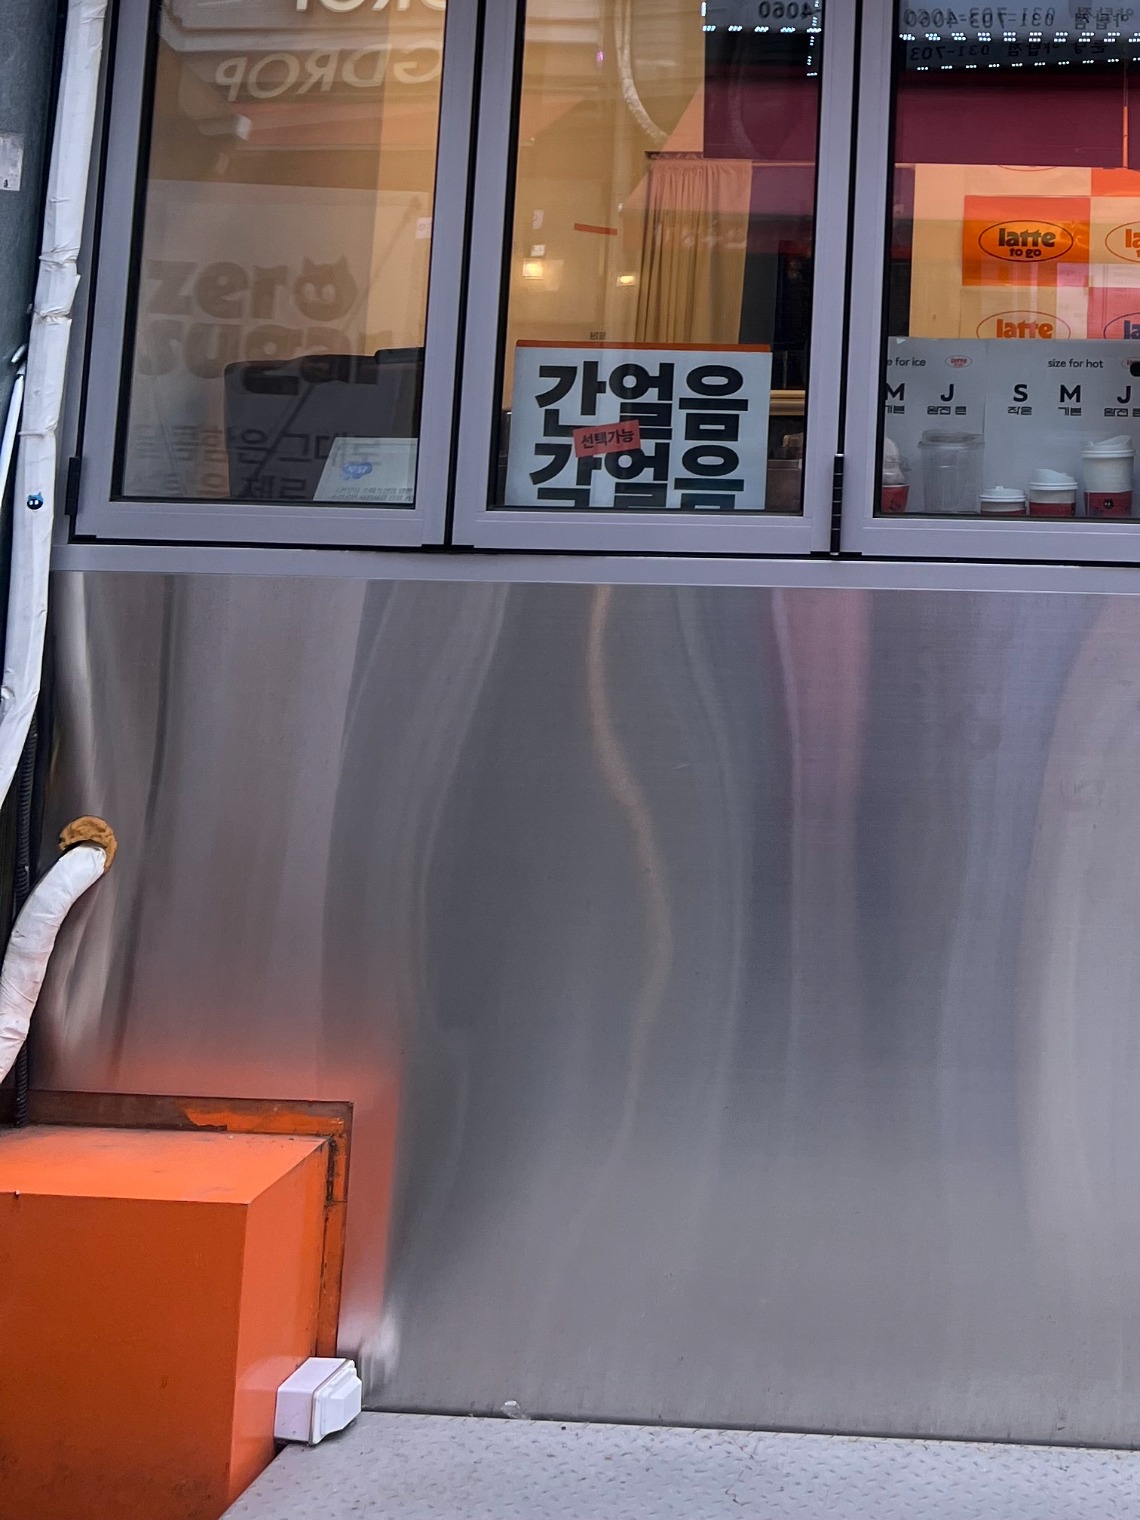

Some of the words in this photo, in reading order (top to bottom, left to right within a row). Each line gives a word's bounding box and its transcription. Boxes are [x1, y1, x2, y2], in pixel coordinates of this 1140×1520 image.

[998, 227, 1056, 248] latte
[1009, 248, 1024, 258] to
[1025, 249, 1042, 259] go
[996, 318, 1054, 339] latte
[895, 357, 911, 367] for
[912, 357, 927, 367] ice
[1047, 358, 1067, 368] size
[1068, 358, 1085, 368] for
[1086, 358, 1104, 369] hot
[940, 383, 955, 402] J
[1013, 384, 1029, 403] S
[1059, 384, 1082, 403] M
[1116, 385, 1132, 404] J
[580, 429, 636, 451] 선택가능
